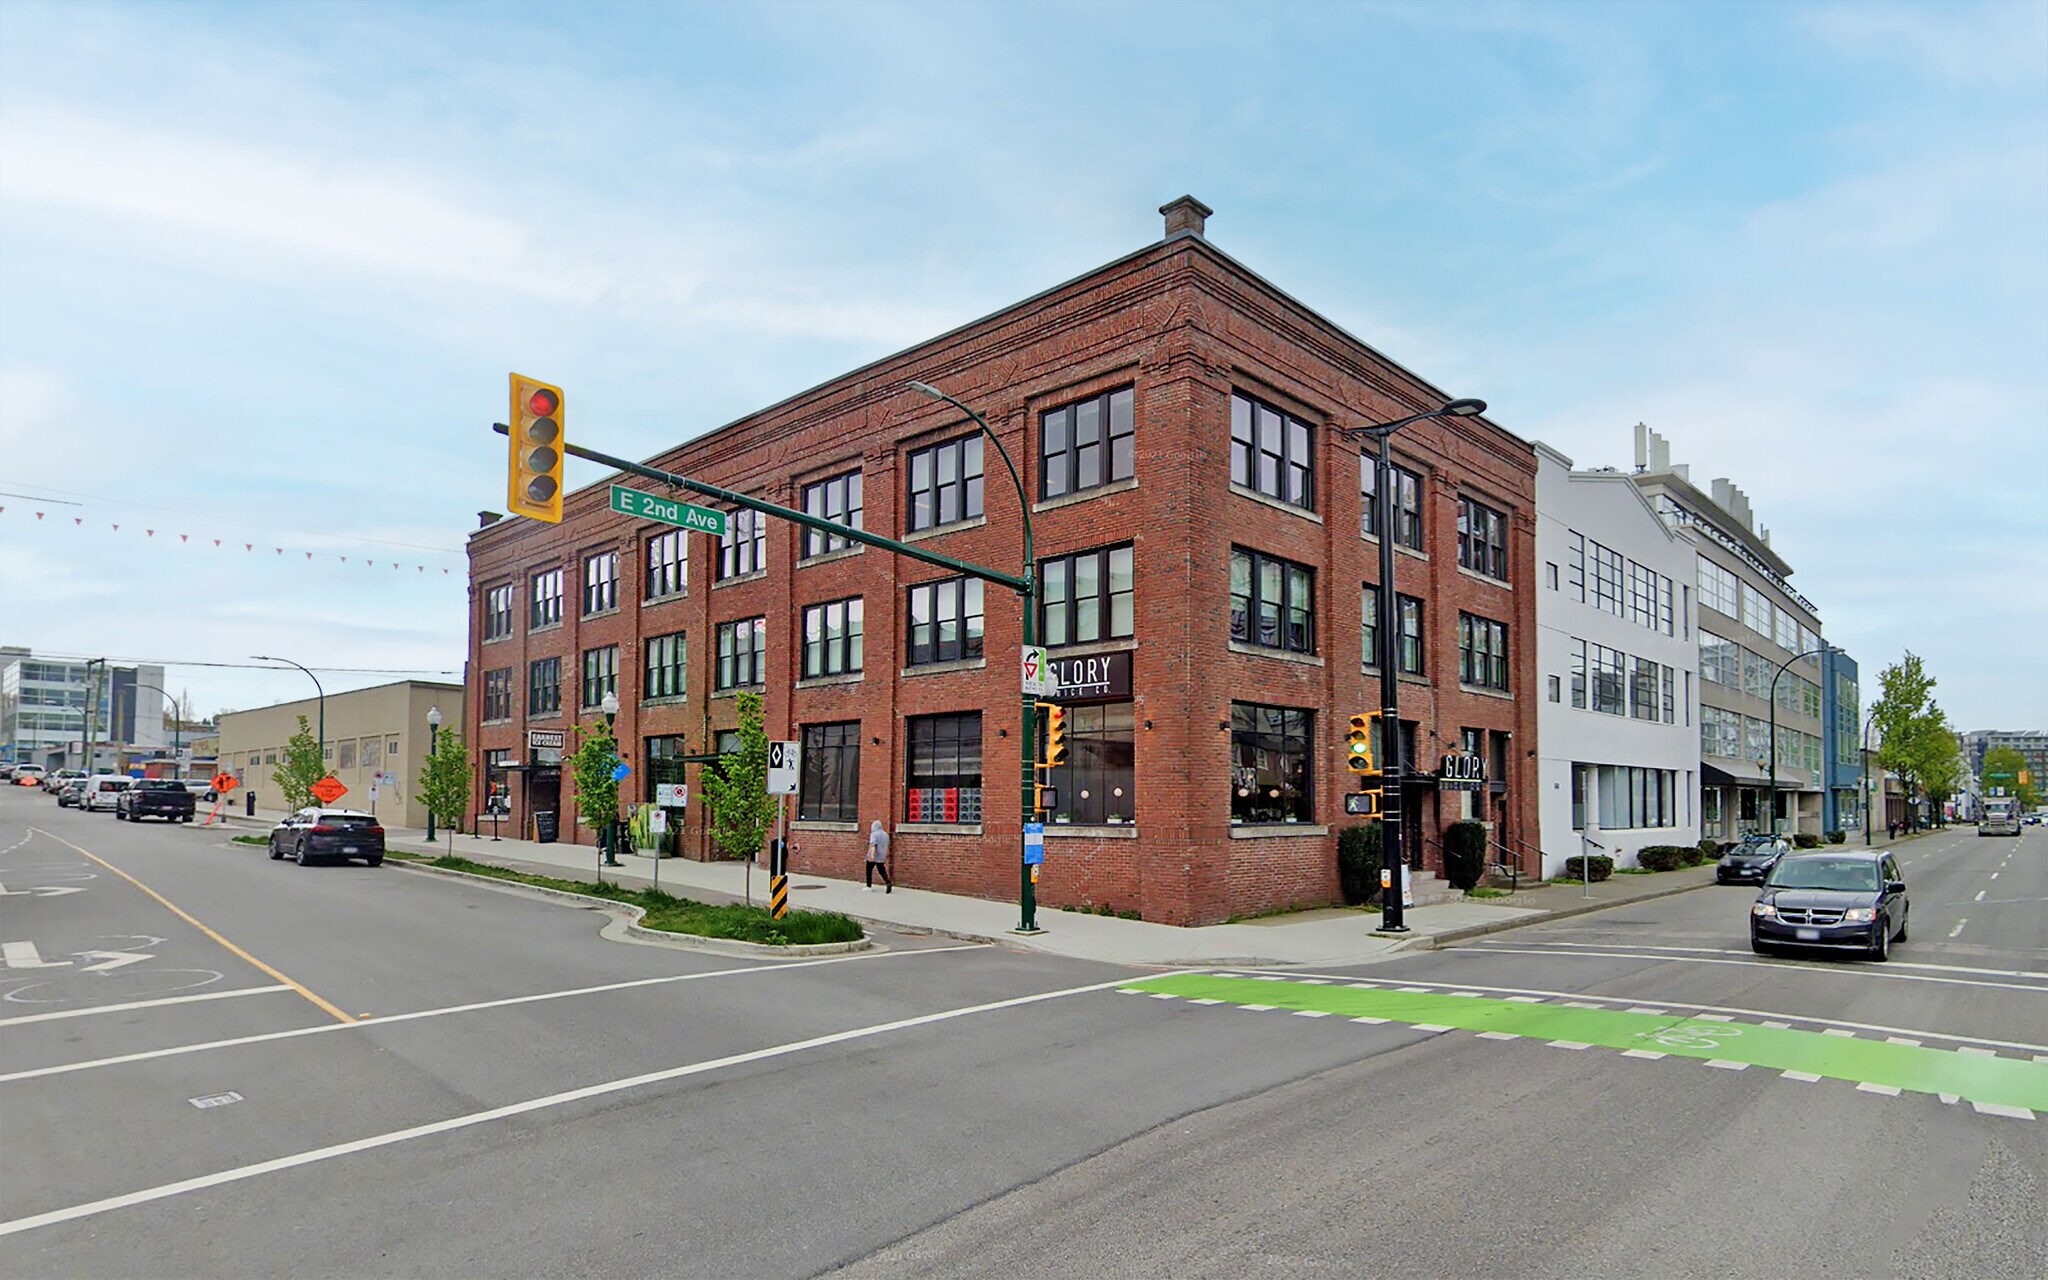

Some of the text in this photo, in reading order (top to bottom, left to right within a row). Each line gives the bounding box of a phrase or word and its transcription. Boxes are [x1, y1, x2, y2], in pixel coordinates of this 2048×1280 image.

[620, 491, 718, 530] E 2nd Ave
[1445, 754, 1489, 779] GLORY
